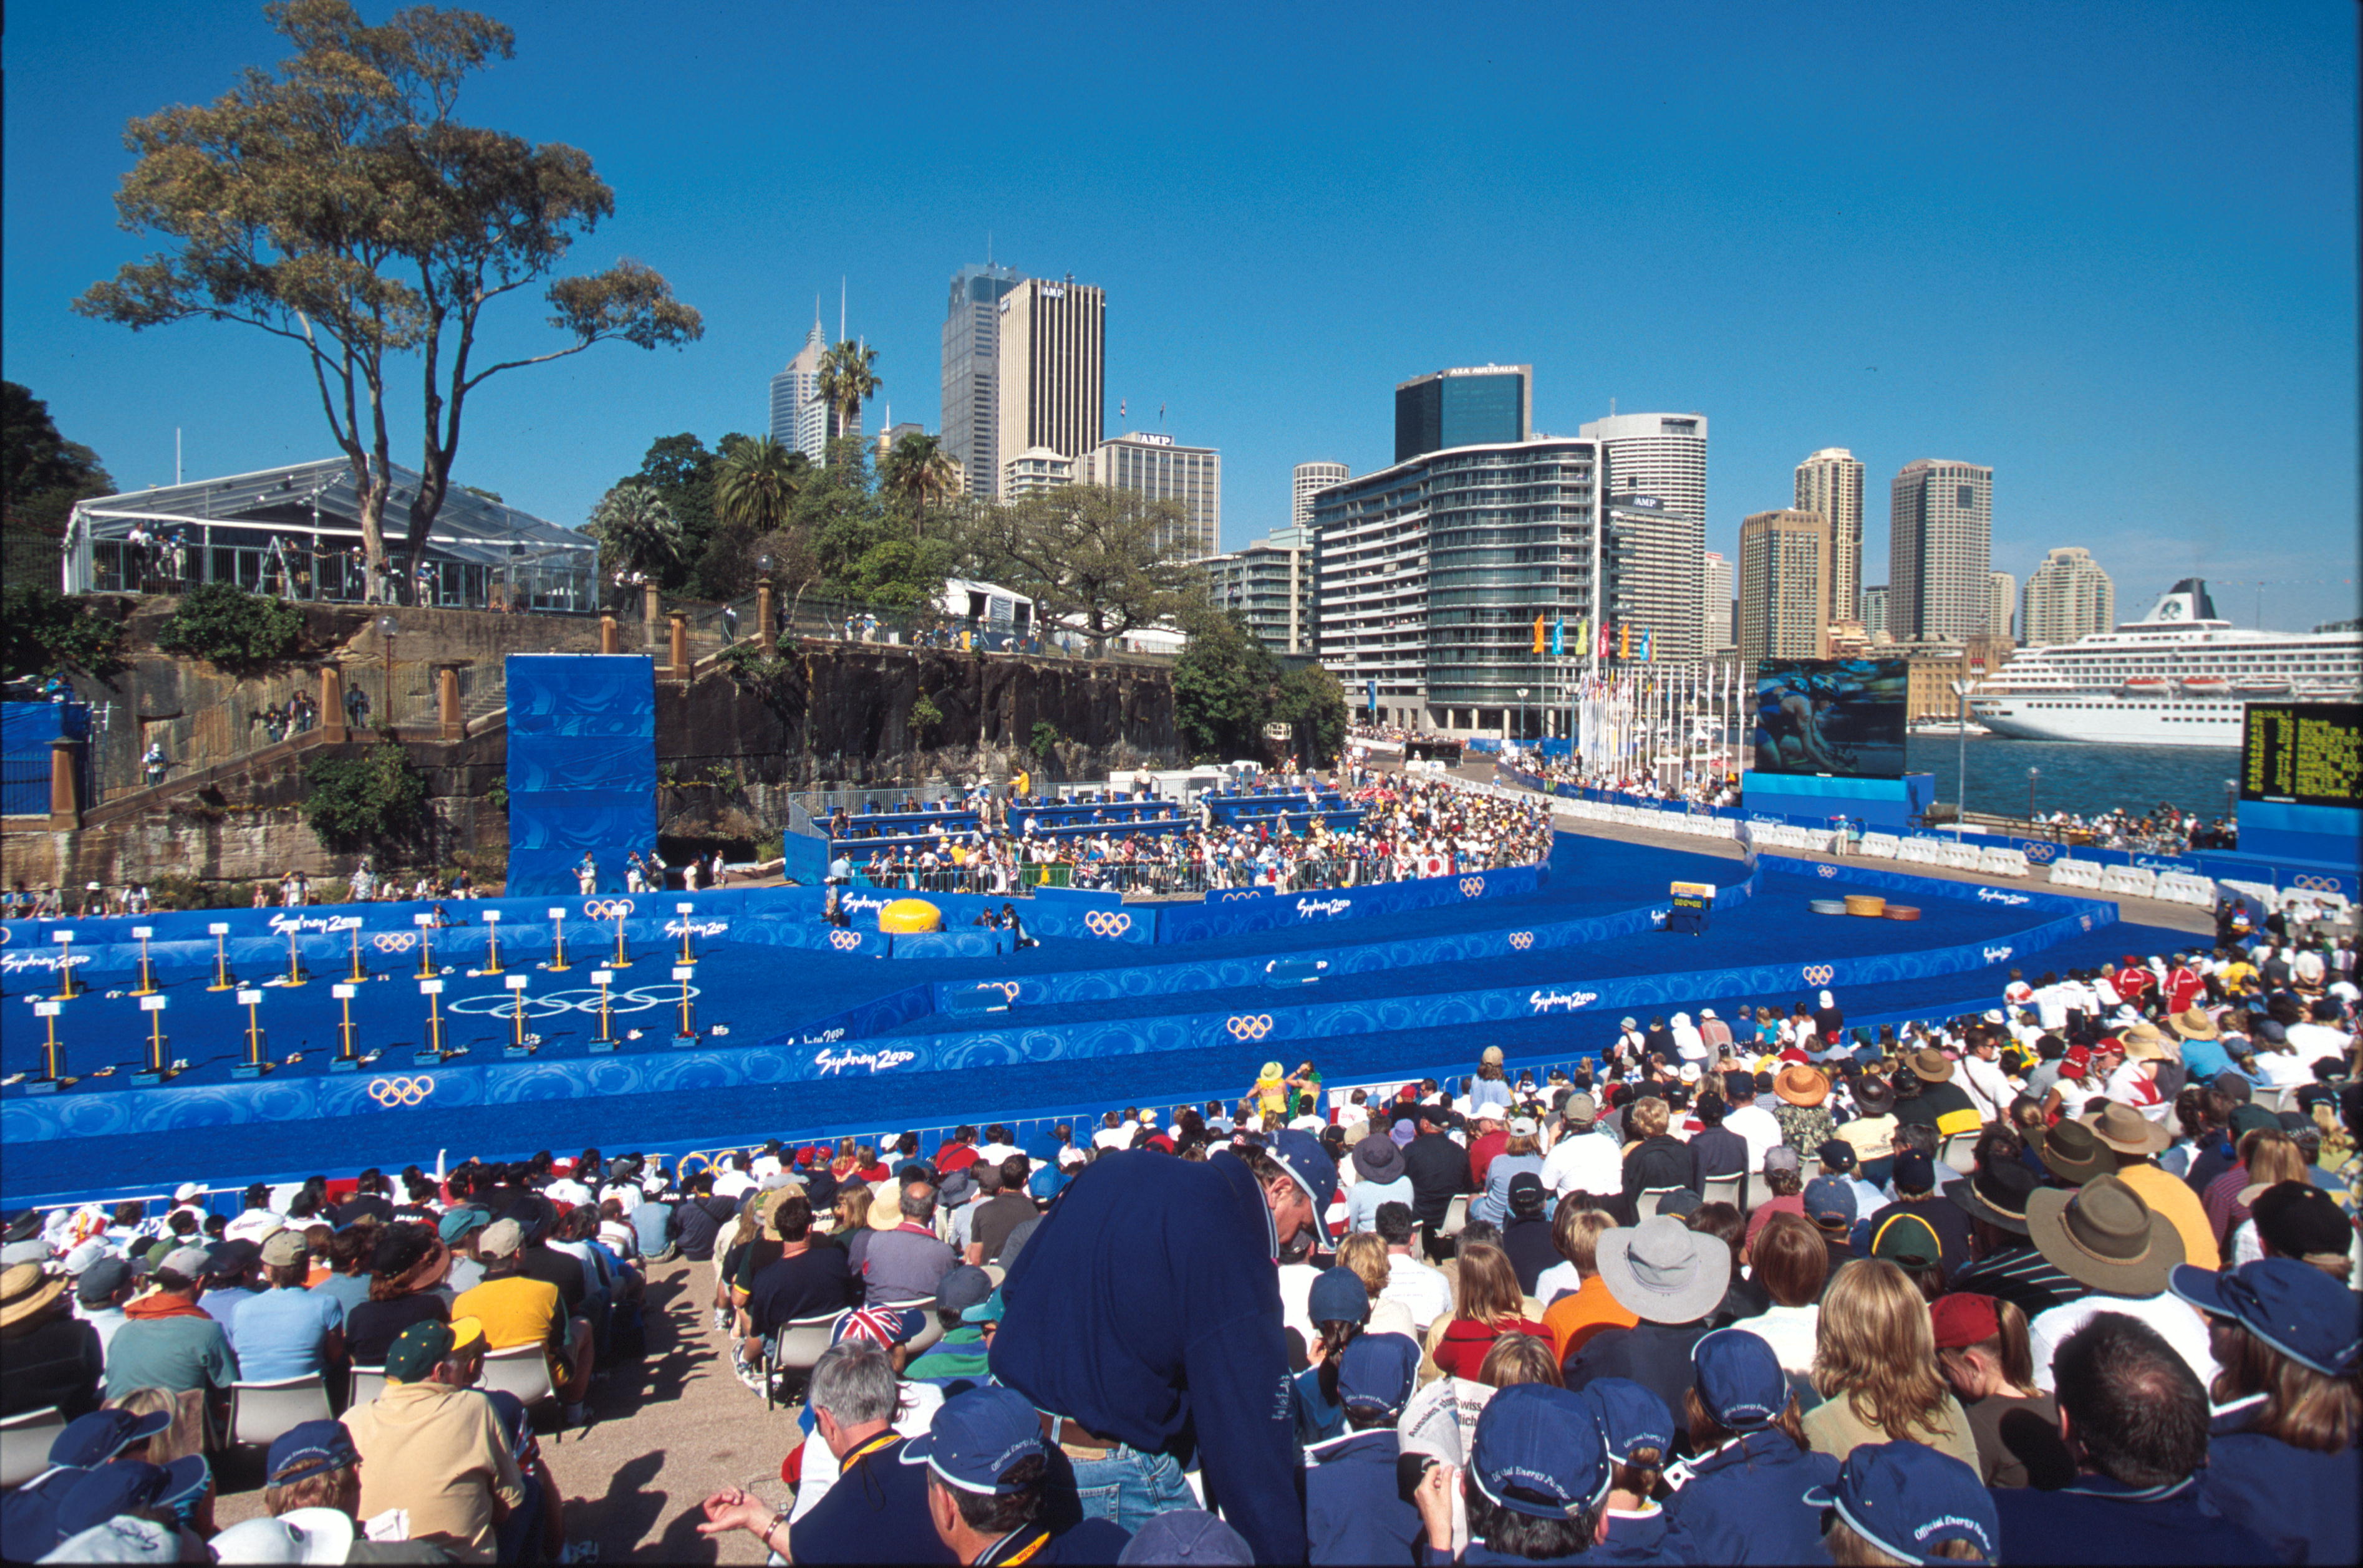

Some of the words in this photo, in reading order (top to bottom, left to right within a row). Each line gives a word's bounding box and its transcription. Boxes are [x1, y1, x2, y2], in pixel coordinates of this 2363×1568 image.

[1042, 286, 1064, 297] AMP
[1472, 365, 1519, 373] AUSTRALIA
[1141, 435, 1171, 446] AMP
[1635, 497, 1656, 507] AMP
[2298, 726, 2346, 736] BOLTON
[2137, 857, 2171, 871] Sydney
[842, 892, 882, 915] Sydney
[1978, 888, 2009, 905] Sydney
[1297, 898, 1331, 918] Sydney
[1331, 898, 1351, 913] 2000
[1, 953, 56, 973] Sydney
[56, 955, 90, 968] 2000
[1530, 990, 1571, 1012] Sydney
[1572, 991, 1597, 1007] 2000
[815, 1048, 876, 1075] Sydney
[876, 1050, 914, 1069] 2000
[1408, 1405, 1440, 1438] Aussies
[1515, 1466, 1545, 1481] Energy
[1914, 1516, 1944, 1542] Official
[1945, 1514, 1974, 1529] Energy
[1017, 1543, 1037, 1562] Kodak
